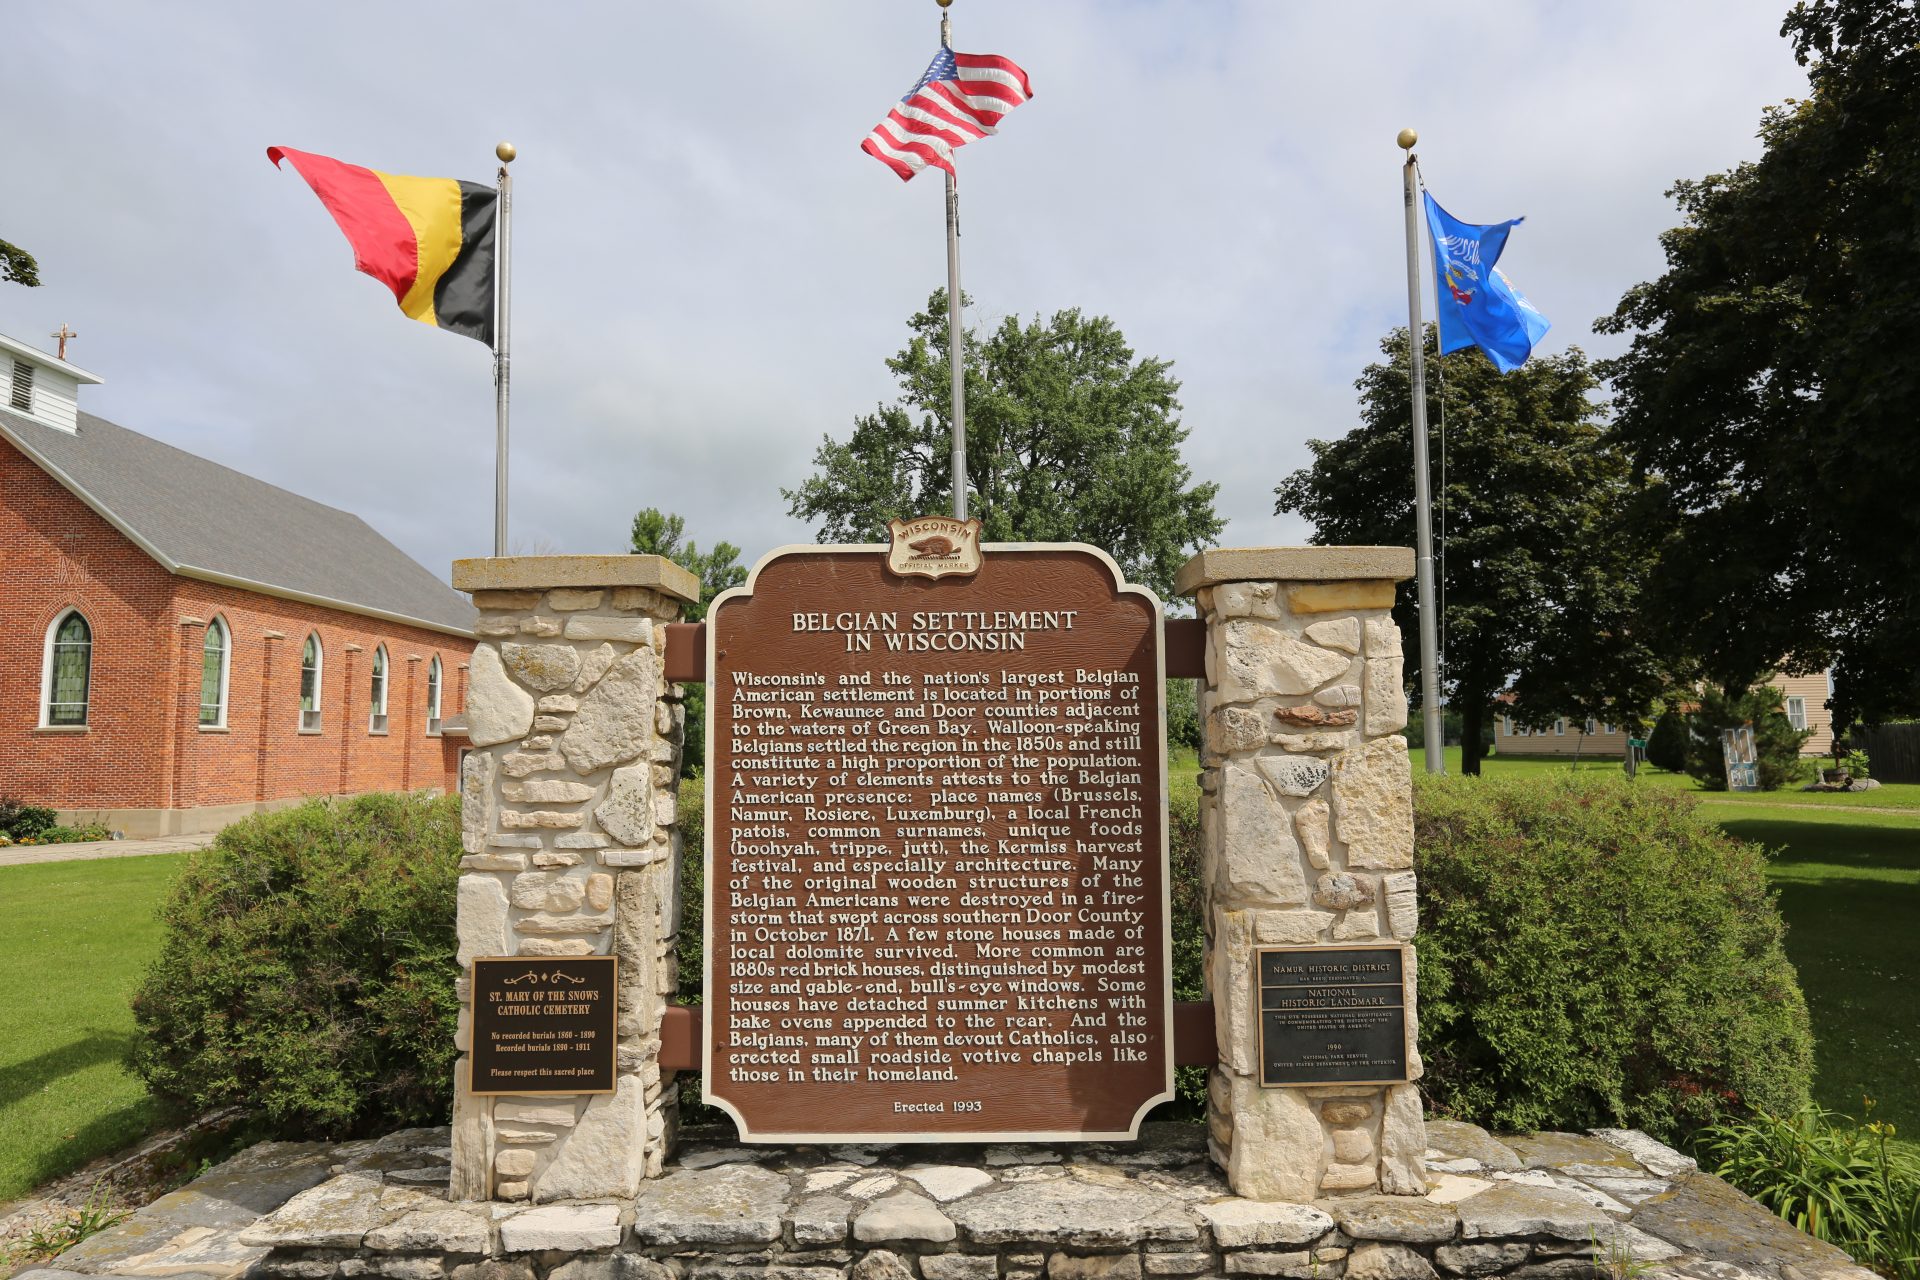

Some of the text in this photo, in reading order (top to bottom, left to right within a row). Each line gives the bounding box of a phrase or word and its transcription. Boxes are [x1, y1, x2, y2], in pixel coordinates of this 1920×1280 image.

[898, 522, 971, 539] WISCONSIN
[792, 610, 1078, 631] BELGIAN SETTLEMENT
[846, 631, 1025, 651] IN WISCONSIN
[731, 669, 1140, 687] Wisconsin's and the nation's largest Belgian
[732, 685, 1140, 704] American settlement is located in portions of
[732, 702, 1140, 720] Brown, Kewaunee and Door counties adjacent
[732, 719, 1140, 737] to the waters of Green Bay. Walloon-speaking
[731, 735, 1142, 756] Belgians settled the region in the 1850s and still
[731, 770, 1142, 789] A variety of elements attests to the Belgian
[731, 804, 1142, 823] Namur, Rosiere, Luxemburg), a local French
[731, 839, 1142, 858] (boohyah, trippe, jutt), the Kermiss harvest
[730, 891, 1144, 910] Belgian Americans were destroyed in a fire-
[730, 943, 1145, 959] local dolomite survived. More common are
[490, 991, 598, 1001] ST. MARY OF THE SNOWS
[1308, 988, 1356, 997] NATIONAL
[498, 1005, 590, 1015] CATHOLIC CEMETERY
[730, 994, 1146, 1011] houses have detached summer kitchens with
[1282, 997, 1385, 1007] HISTORIC LANDMARK
[730, 1047, 1148, 1066] erected small roadside votive chapels like
[514, 1069, 537, 1077] respect
[578, 1068, 594, 1076] place
[894, 1100, 982, 1112] Erected 1993
